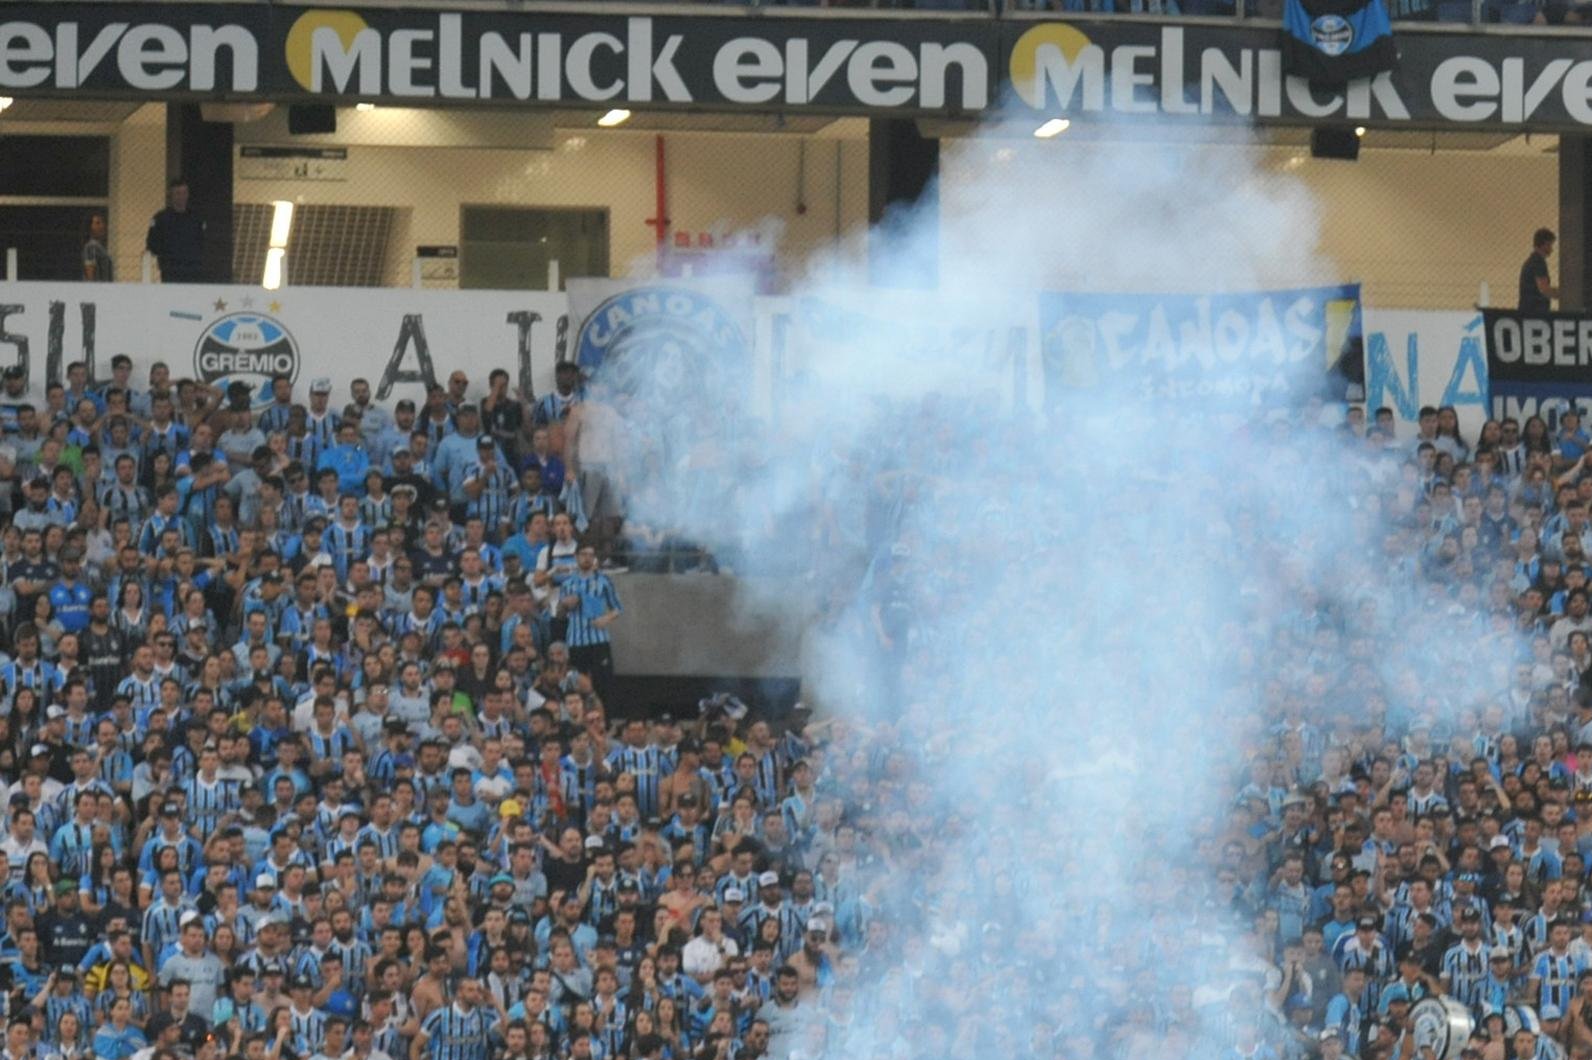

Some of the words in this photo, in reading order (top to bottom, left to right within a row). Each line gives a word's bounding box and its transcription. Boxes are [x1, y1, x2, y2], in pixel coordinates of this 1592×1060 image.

[0, 20, 258, 90] even
[713, 35, 988, 110] even
[1099, 296, 1322, 370] CANOAS
